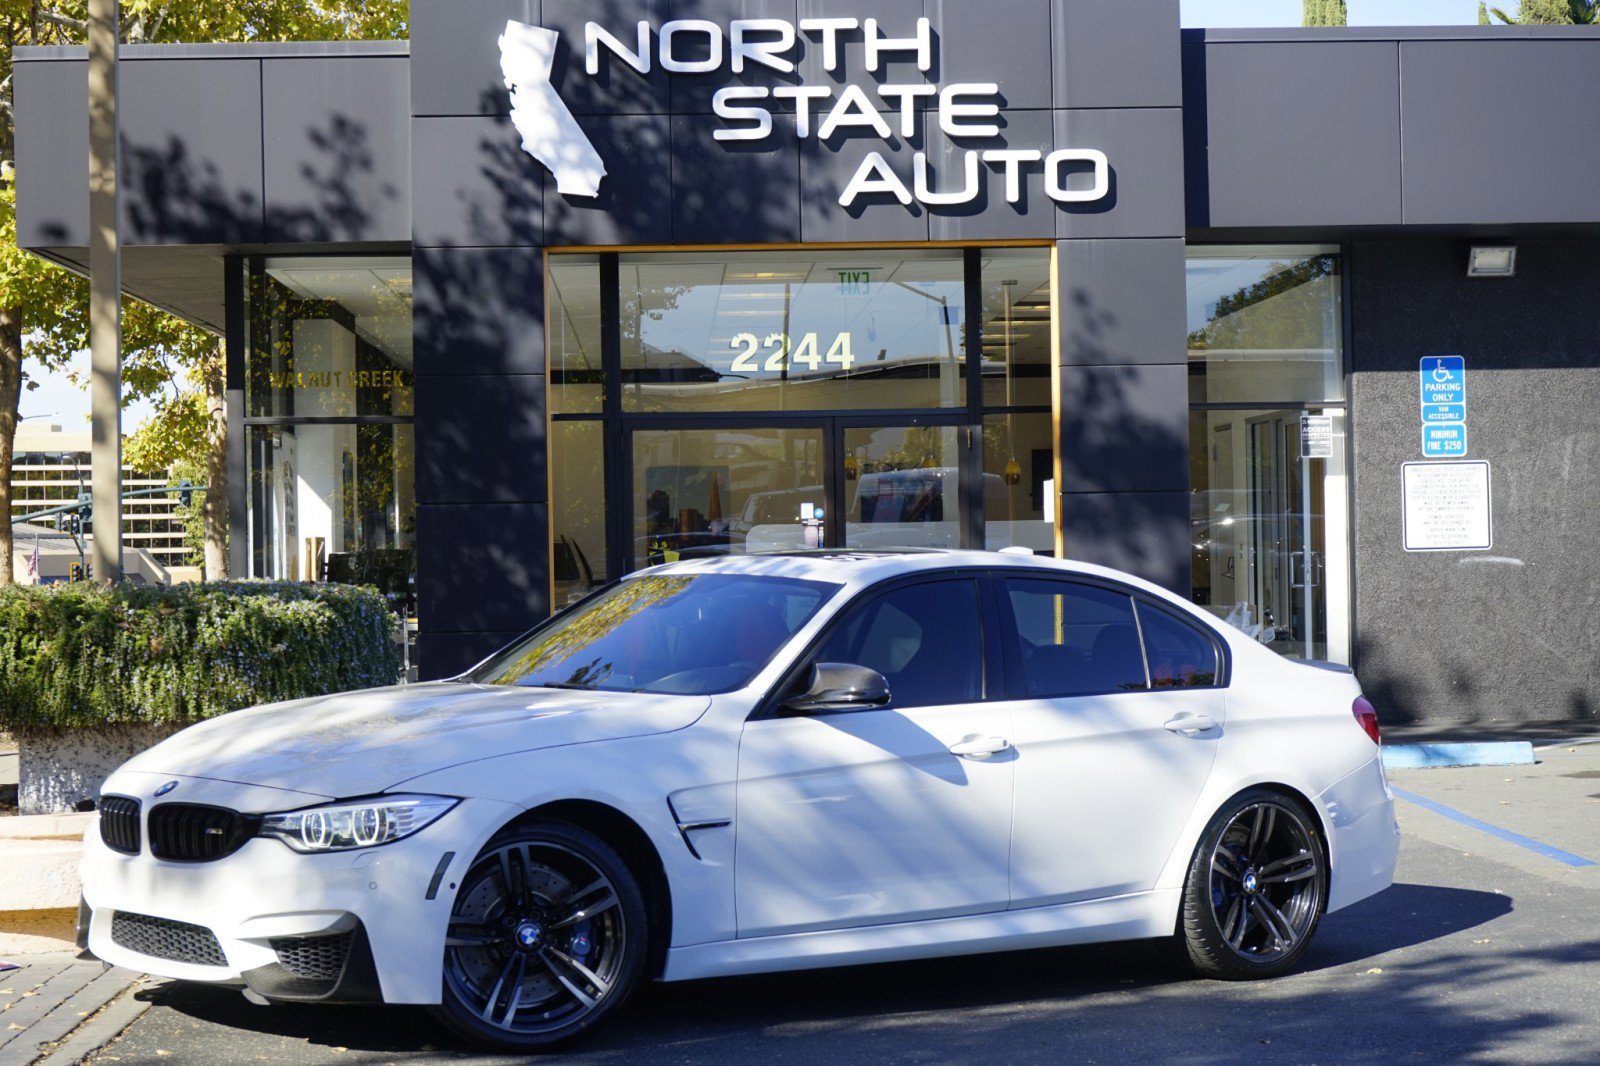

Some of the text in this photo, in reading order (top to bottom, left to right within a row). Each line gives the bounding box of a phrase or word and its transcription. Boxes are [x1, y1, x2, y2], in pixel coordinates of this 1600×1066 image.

[585, 17, 930, 75] NORTH
[712, 83, 999, 140] STATE
[838, 149, 1109, 206] AUTO
[730, 332, 855, 372] 2244
[269, 370, 404, 388] WALNUT CREEK
[1425, 383, 1461, 392] PARKING
[1432, 393, 1454, 402] ONLY
[1431, 430, 1458, 439] MINIMUM
[1427, 440, 1462, 450] FINE $250
